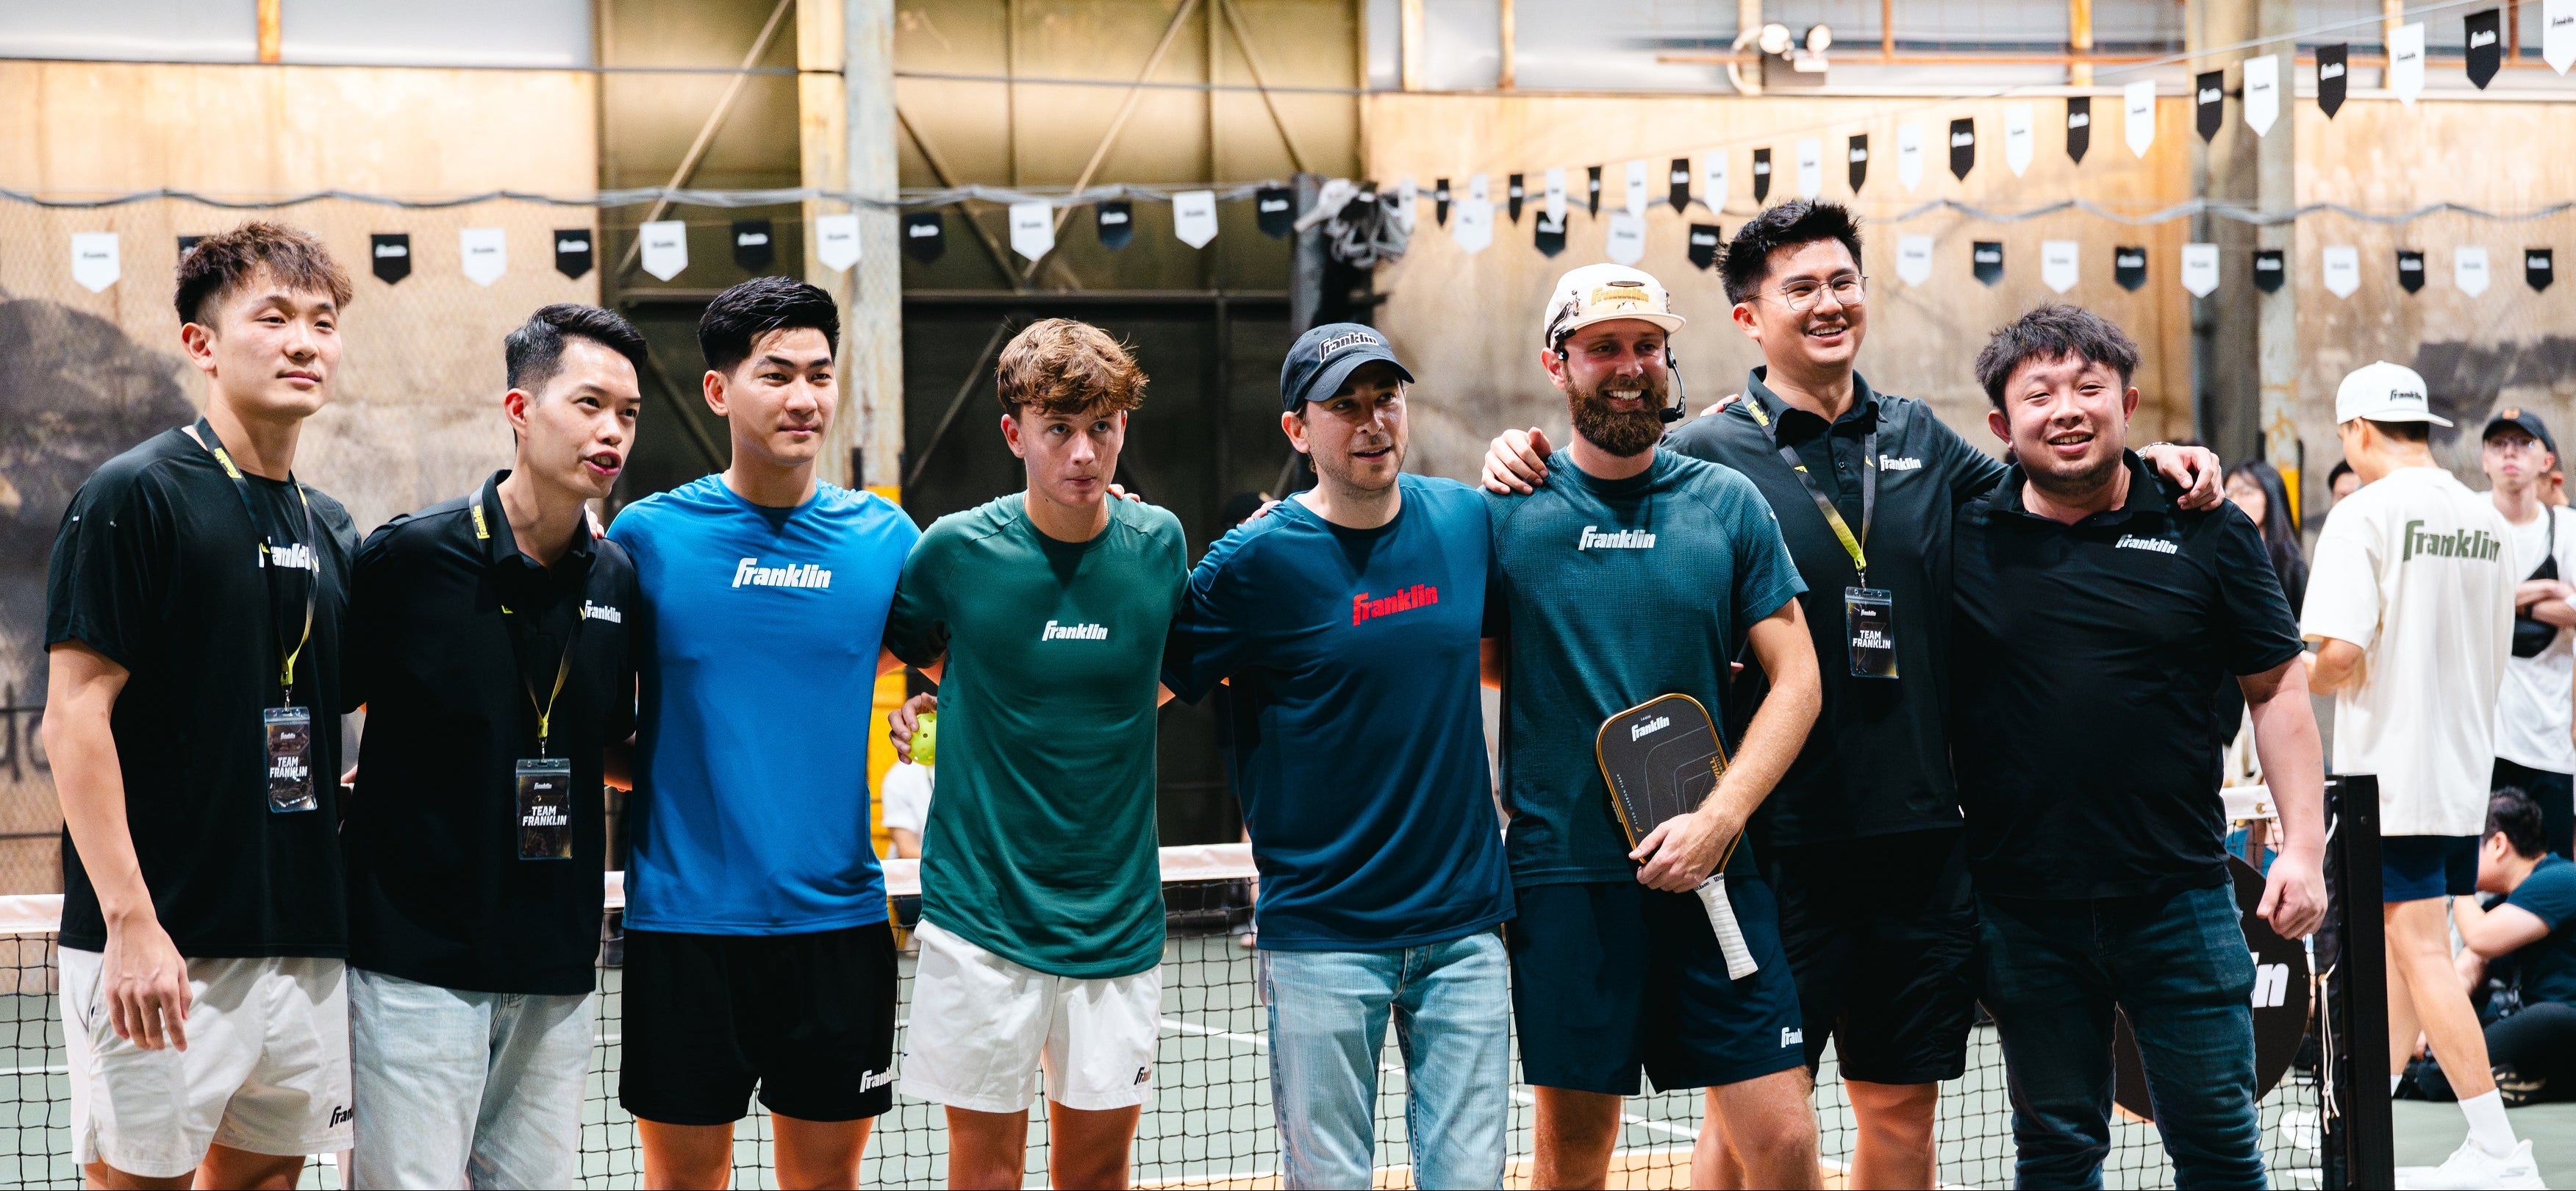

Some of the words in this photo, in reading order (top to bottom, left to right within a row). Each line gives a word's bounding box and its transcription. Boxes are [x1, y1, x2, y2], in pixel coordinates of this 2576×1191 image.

[1319, 332, 1379, 363] Franklin
[1879, 454, 1922, 471] Franklin
[1578, 525, 1656, 551] Franklin
[2115, 534, 2178, 554] Franklin
[2403, 519, 2501, 563] Franklin
[731, 557, 832, 589] Franklin
[584, 599, 621, 624] Franklin
[1353, 583, 1439, 626] Franklin
[1041, 620, 1109, 642] Franklin
[1859, 629, 1882, 640] TEAM
[1853, 637, 1891, 649] FRANKLIN
[1631, 716, 1670, 742] Franklin
[269, 765, 308, 779] FRANKLIN
[277, 756, 299, 768] TEAM
[522, 815, 568, 826] FRANKLIN
[532, 805, 557, 817] TEAM
